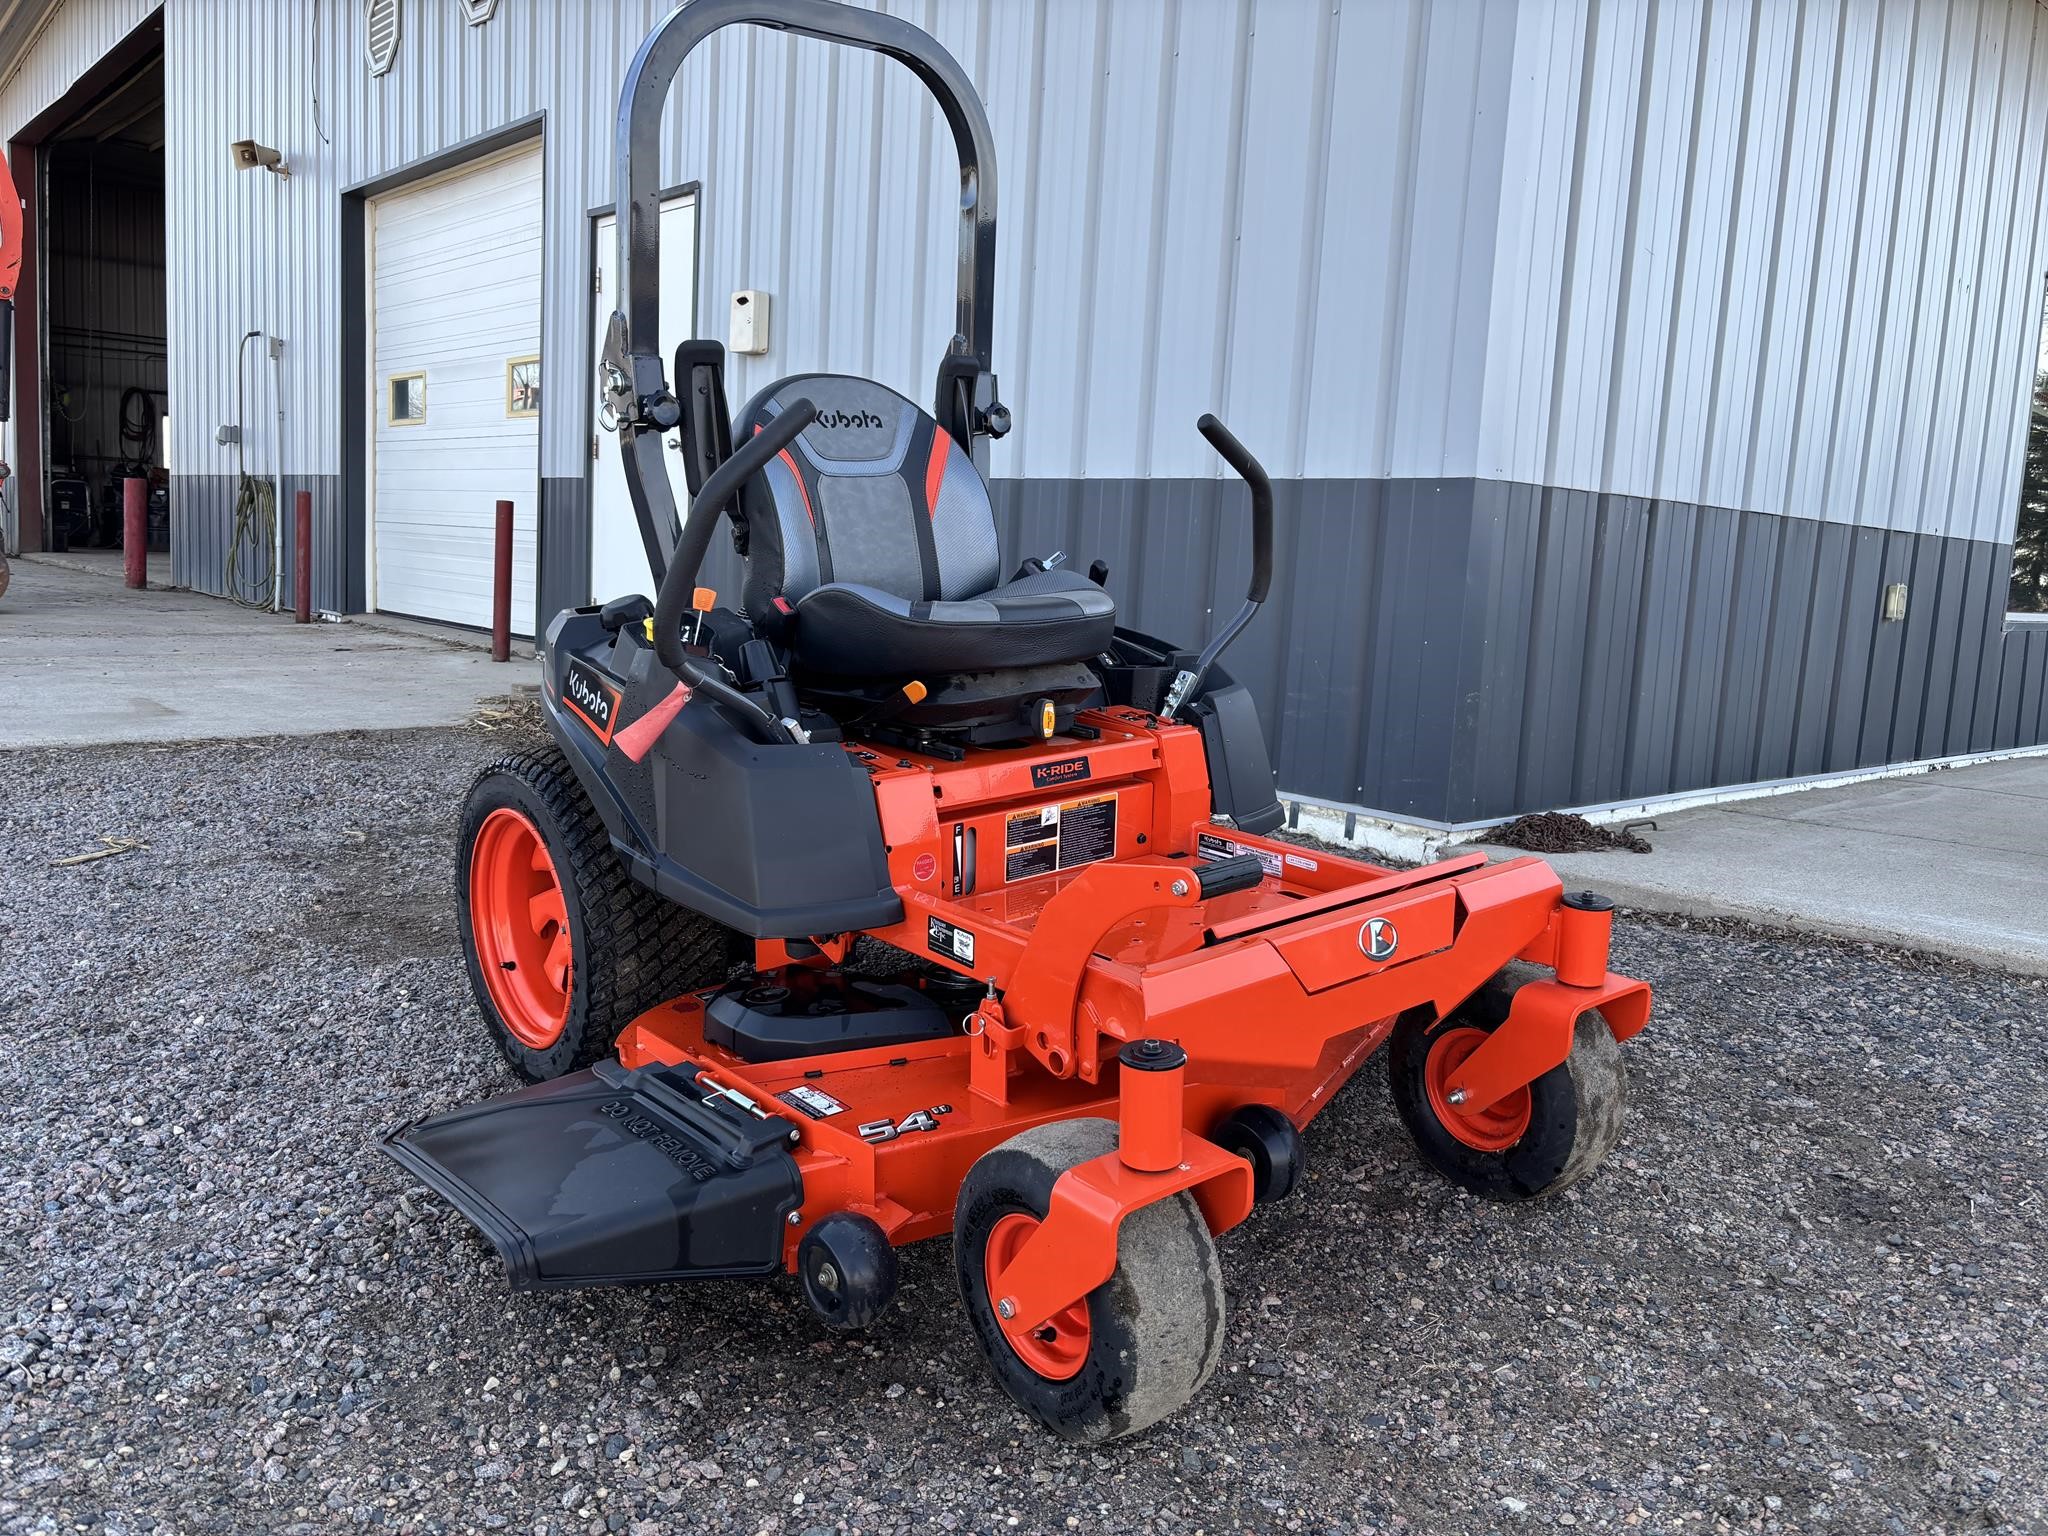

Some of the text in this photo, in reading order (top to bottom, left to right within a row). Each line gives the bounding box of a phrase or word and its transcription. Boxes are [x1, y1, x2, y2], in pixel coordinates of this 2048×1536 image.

[812, 409, 883, 429] Kubota
[569, 669, 608, 721] Kubota
[1037, 761, 1084, 779] K-RIDE
[955, 825, 961, 834] F
[954, 884, 961, 893] E
[600, 1100, 720, 1181] DO NOT REMOVE
